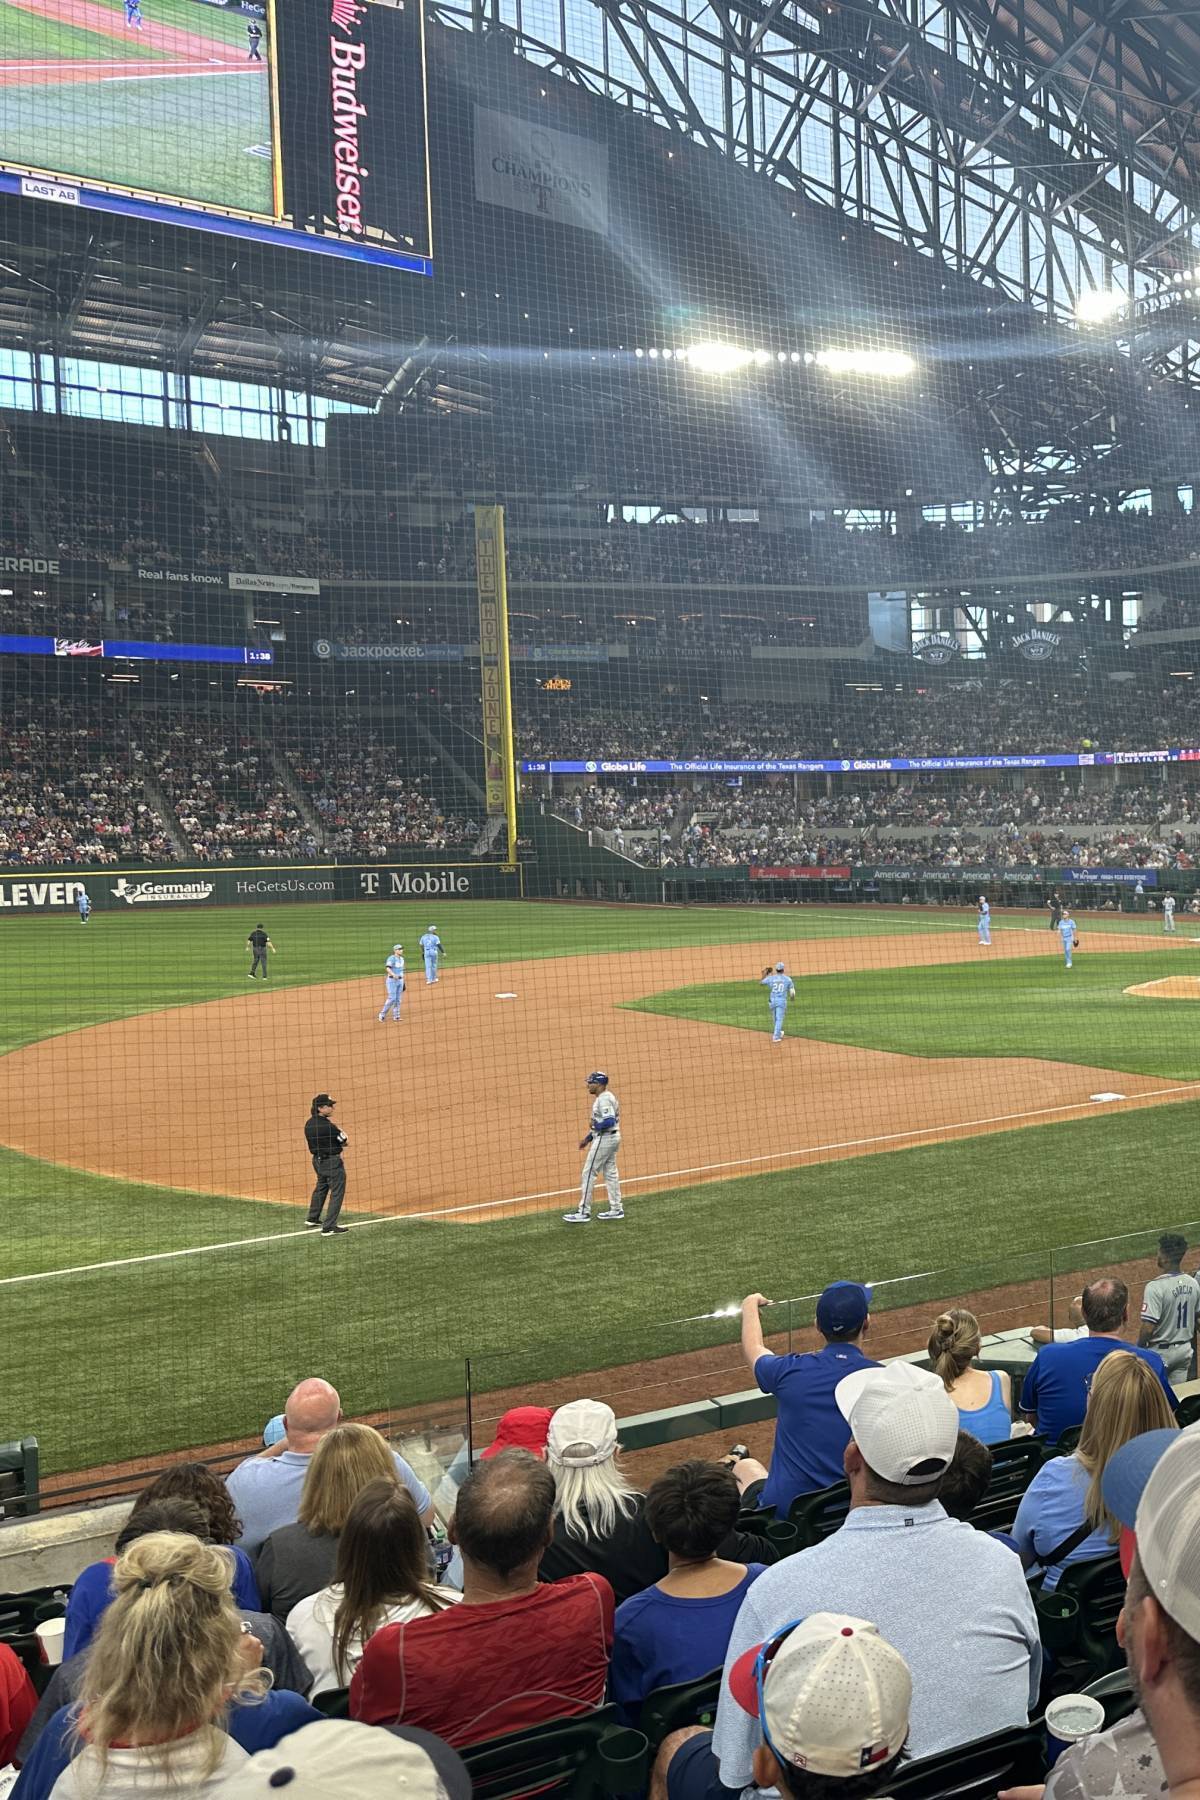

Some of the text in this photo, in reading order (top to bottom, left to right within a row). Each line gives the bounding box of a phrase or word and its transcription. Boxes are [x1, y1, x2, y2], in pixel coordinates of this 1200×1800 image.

[331, 36, 368, 233] Budweiser
[491, 157, 591, 198] CHAMPIONS
[25, 183, 76, 200] LAST AB
[138, 569, 223, 584] Real fans know.
[484, 604, 494, 652] HOT
[1011, 631, 1030, 648] JACK
[250, 652, 271, 661] 1:38
[341, 646, 424, 658] Jackpocket
[487, 668, 497, 733] ZONE
[601, 762, 628, 771] Globe
[630, 762, 646, 771] Life
[854, 761, 875, 770] Globe
[877, 760, 891, 769] Life
[874, 871, 910, 879] American
[923, 871, 949, 879] American
[963, 871, 990, 879] American
[1003, 872, 1033, 880] American
[142, 880, 213, 894] Germania
[236, 879, 335, 893] HeGetsUs.com
[360, 871, 470, 894] T Mobile
[772, 983, 785, 993] 20
[1172, 1285, 1193, 1298] GARCIA
[1176, 1300, 1188, 1329] 11
